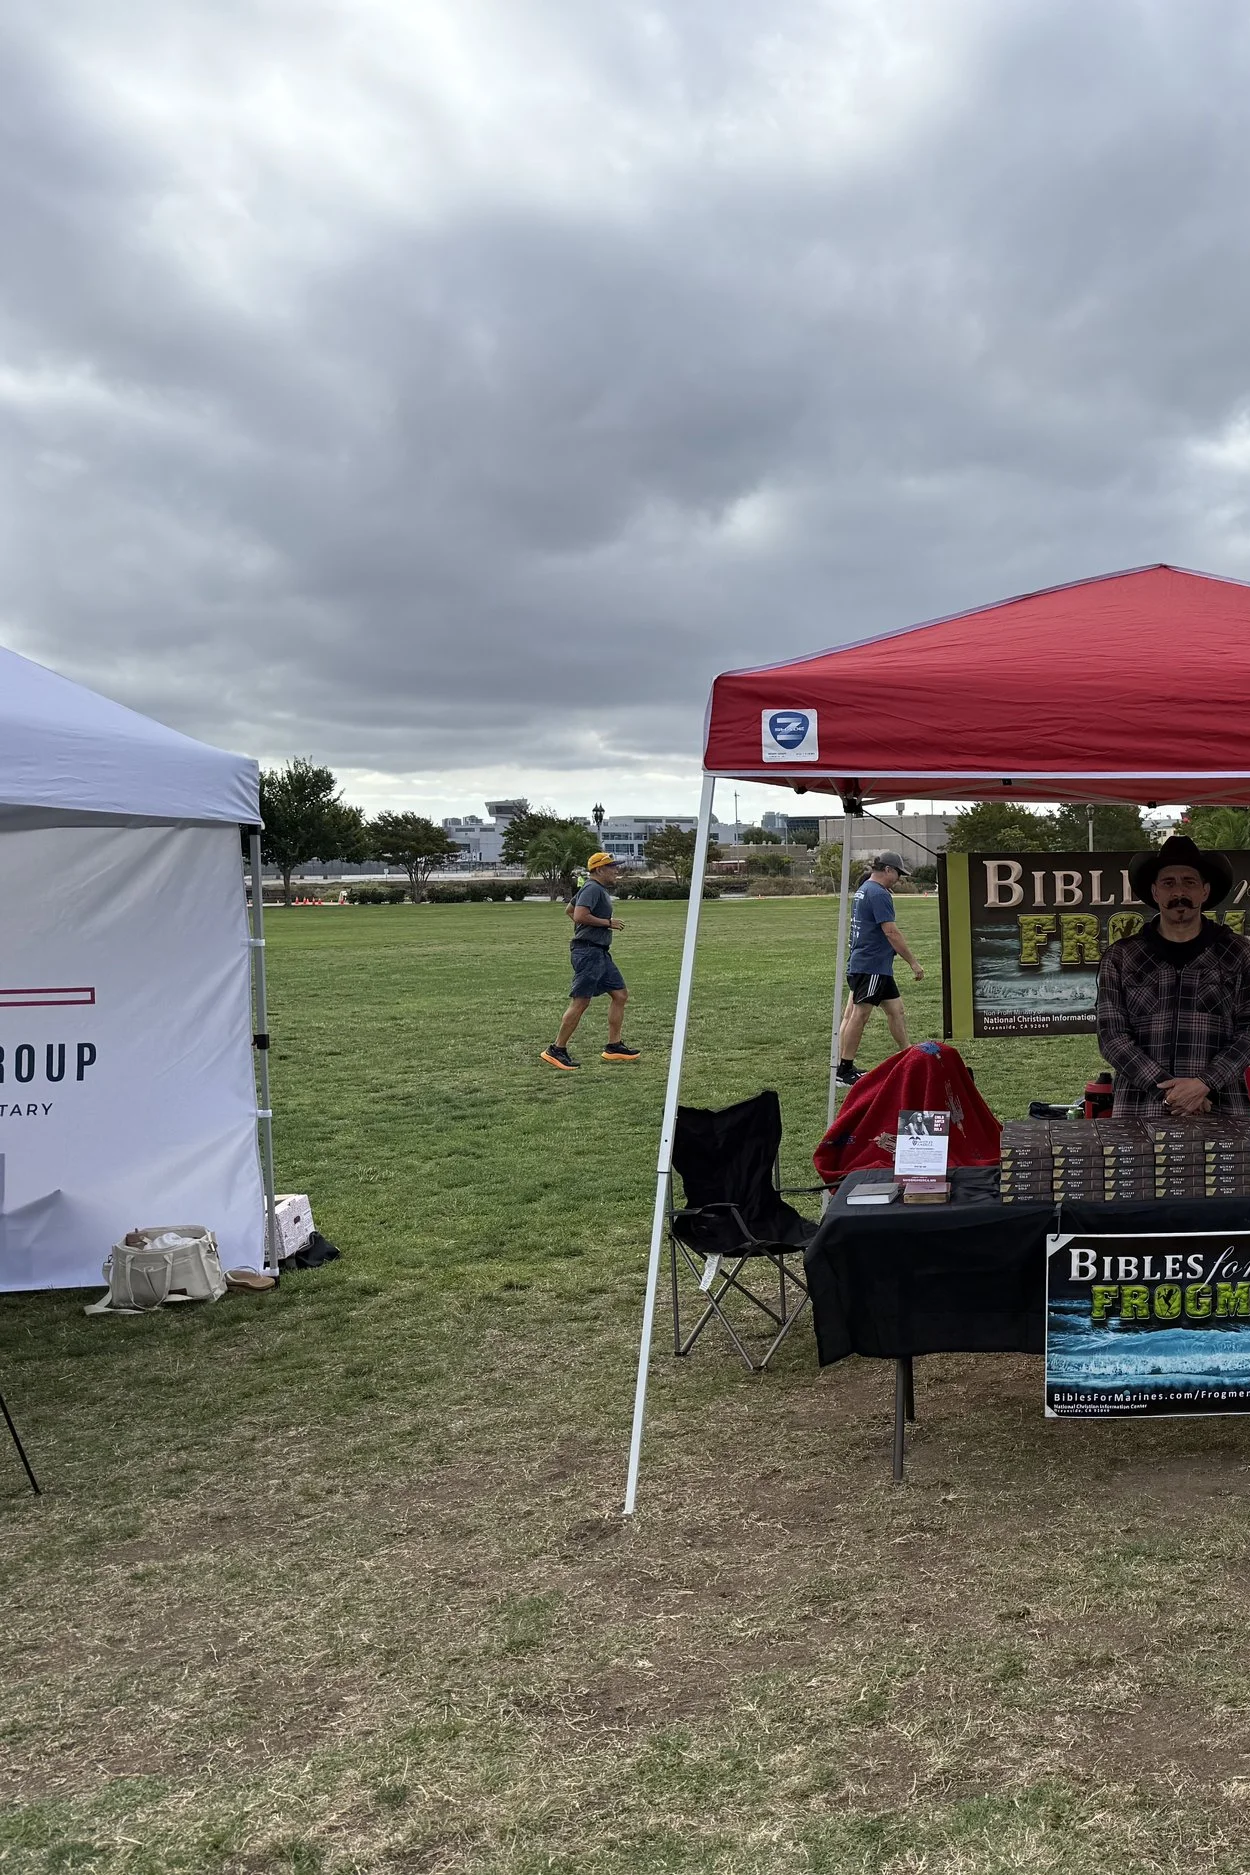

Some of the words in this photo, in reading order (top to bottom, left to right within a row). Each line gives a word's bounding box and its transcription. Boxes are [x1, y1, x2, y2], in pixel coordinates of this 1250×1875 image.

[984, 1016, 1015, 1024] National
[1052, 1014, 1096, 1022] Information
[0, 1042, 96, 1083] OUP
[1068, 1248, 1204, 1282] BIBLES
